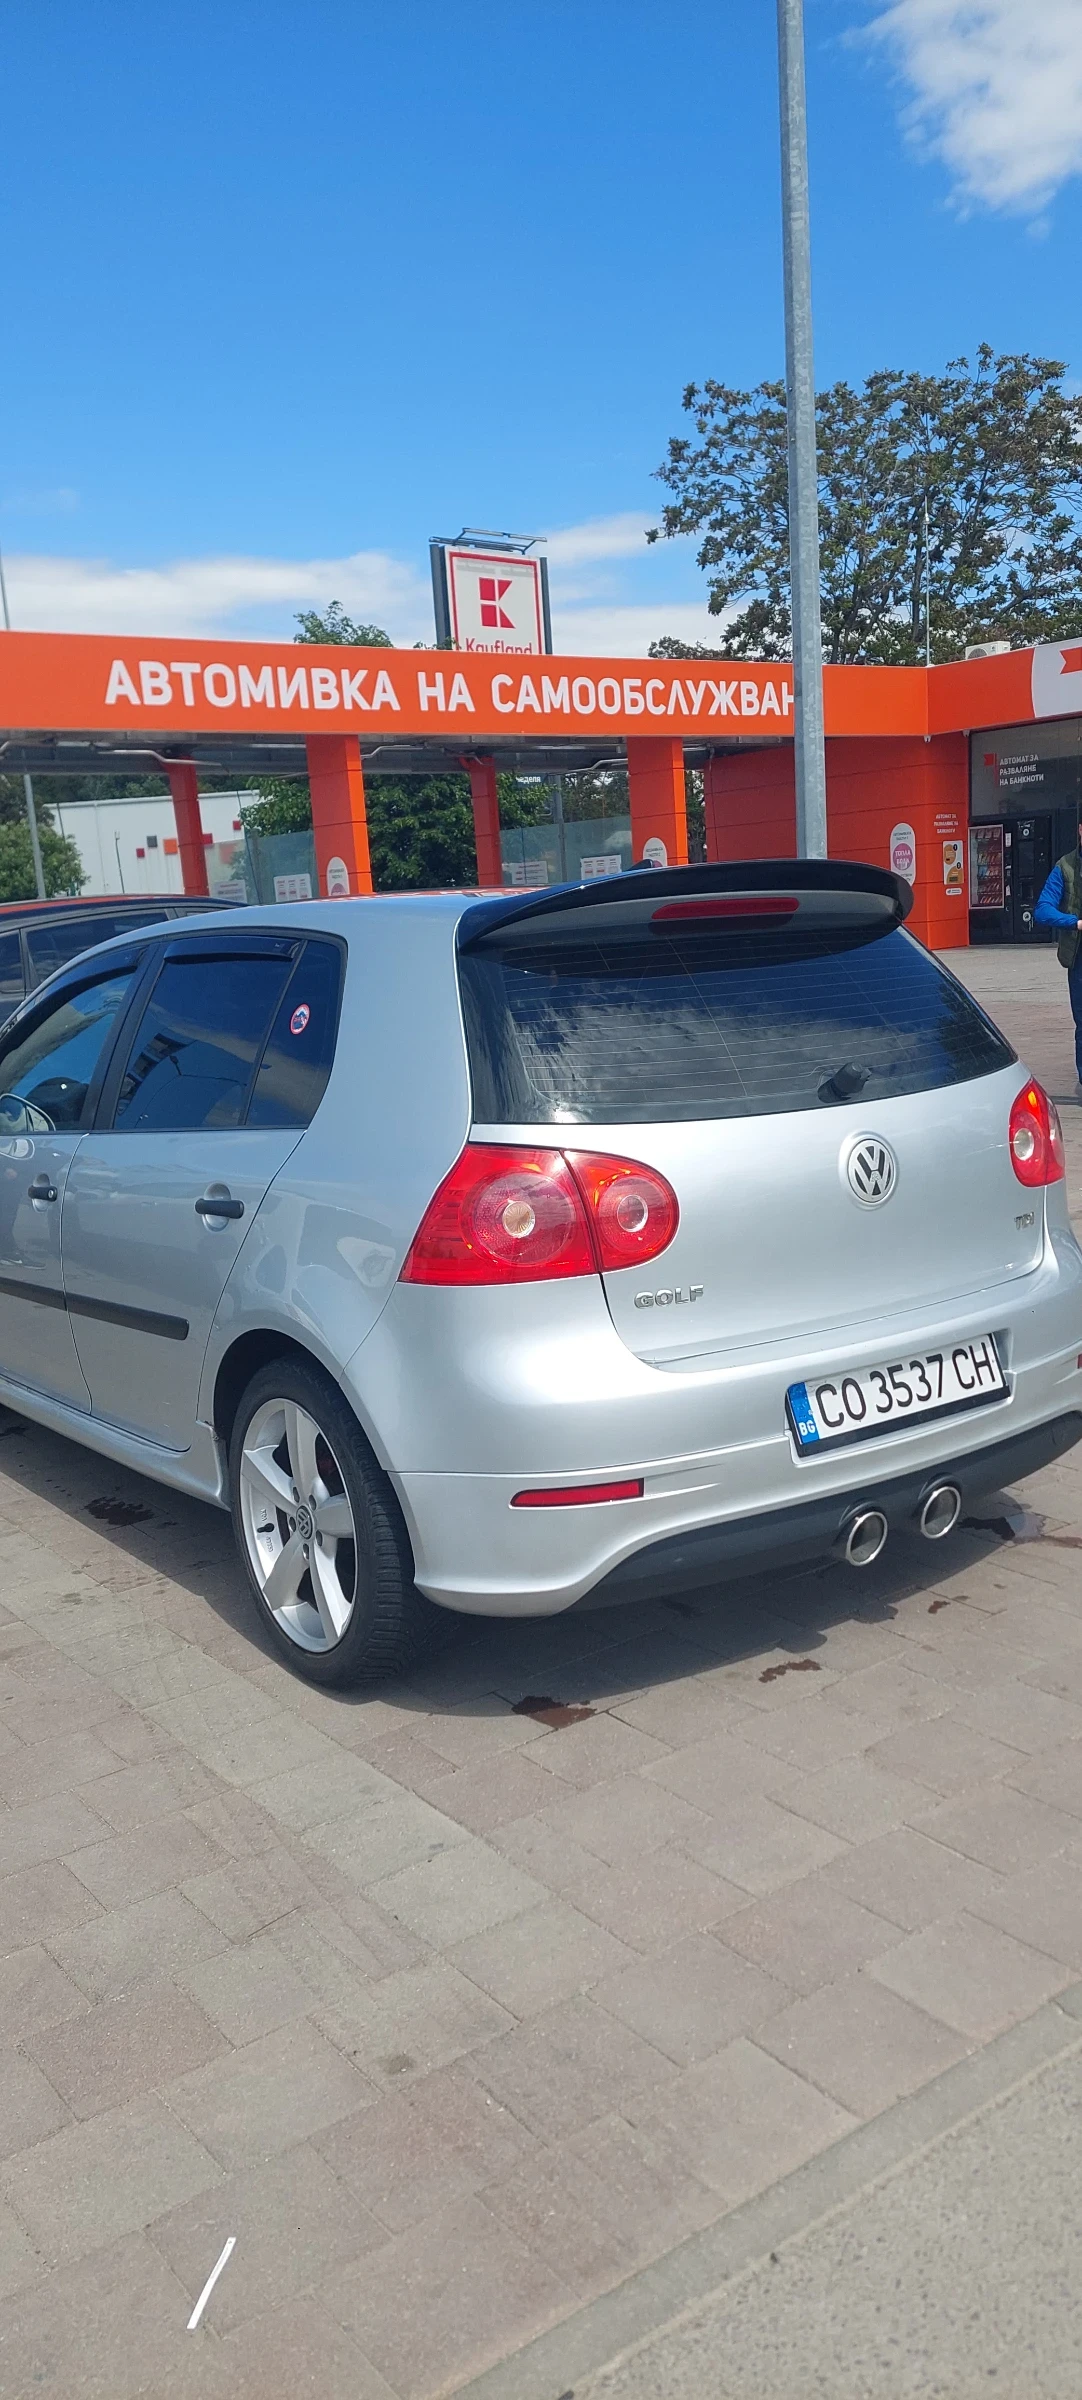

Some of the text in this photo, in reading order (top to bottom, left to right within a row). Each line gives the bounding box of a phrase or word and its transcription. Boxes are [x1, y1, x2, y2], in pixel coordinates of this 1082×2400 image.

[105, 660, 400, 711] АВТОМИВКА
[418, 671, 475, 712] НА
[1000, 754, 1039, 765] АВТОМАТ ЗА
[1000, 764, 1036, 776] РАЗВАЛЯНЕ
[1000, 774, 1044, 786] НА БАНКНОТИ
[634, 1284, 704, 1310] GOLF
[869, 1353, 943, 1414] 3537
[952, 1341, 996, 1390] CH
[799, 1419, 816, 1437] BG
